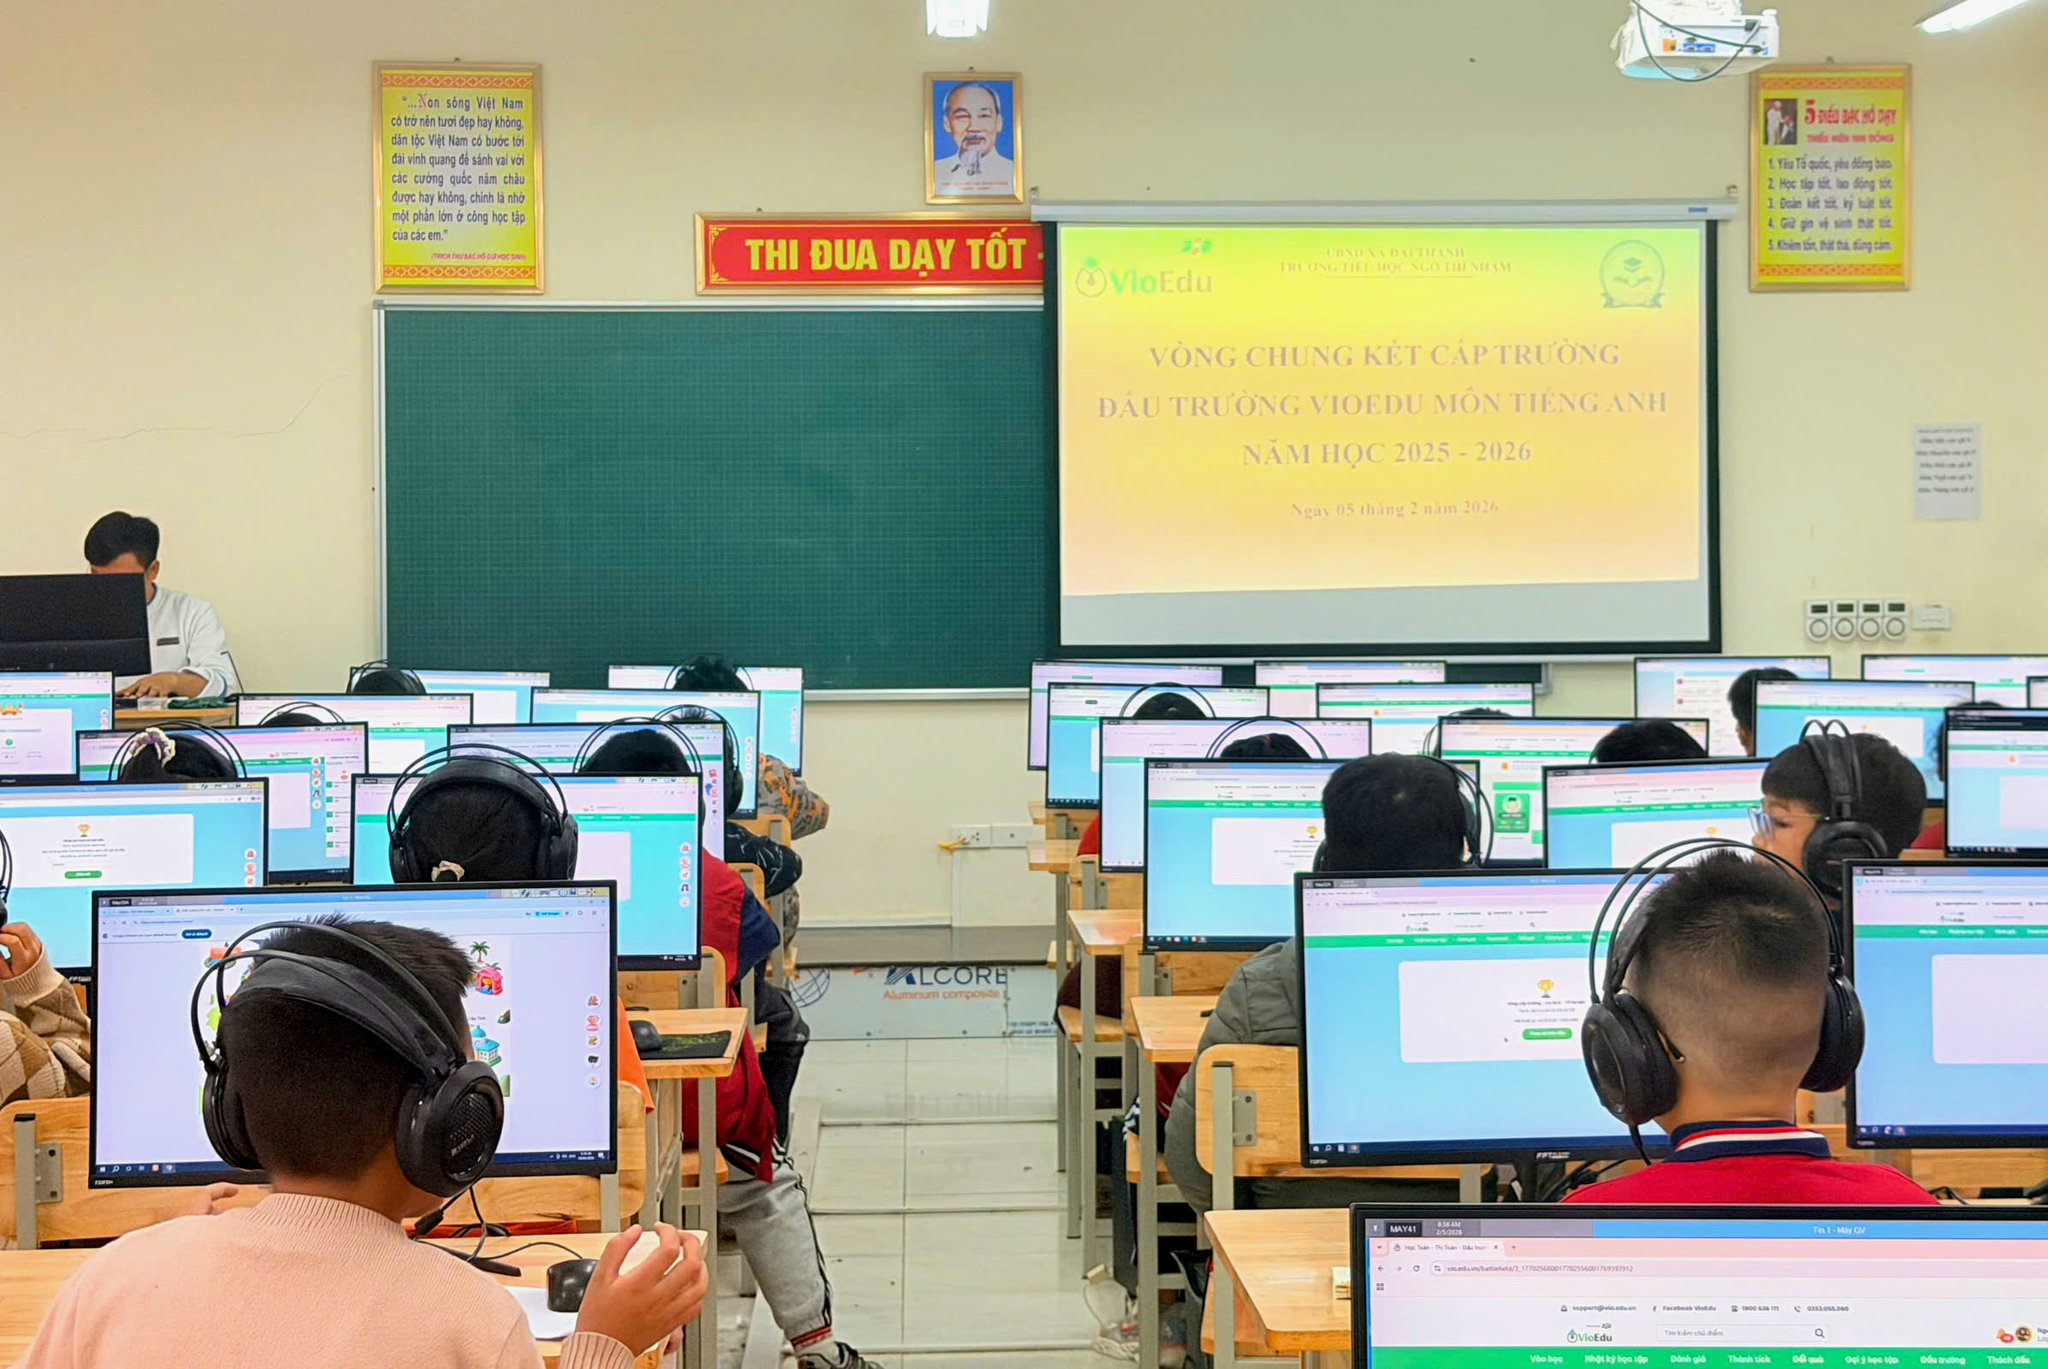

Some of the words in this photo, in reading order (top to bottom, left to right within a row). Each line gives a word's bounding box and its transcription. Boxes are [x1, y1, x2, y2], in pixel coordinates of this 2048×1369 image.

[447, 96, 470, 111] sông
[476, 96, 495, 110] Việt
[502, 97, 523, 109] Nam
[1805, 99, 1816, 124] 5
[391, 115, 401, 127] có
[404, 115, 417, 127] trở
[420, 115, 436, 127] nên
[438, 116, 457, 127] tươi
[458, 116, 475, 130] đẹp
[477, 116, 492, 130] hay
[391, 134, 407, 146] dân
[411, 134, 425, 148] tộc
[428, 134, 445, 149] Việt
[448, 136, 468, 146] Nam
[472, 135, 482, 147] có
[486, 134, 509, 147] bước
[512, 135, 524, 147] tới
[392, 173, 407, 184] các
[414, 173, 444, 187] cường
[450, 170, 472, 186] quốc
[478, 173, 497, 184] năm
[504, 173, 525, 184] châu
[392, 192, 416, 206] được
[419, 192, 434, 206] hay
[470, 191, 494, 204] chính
[497, 191, 504, 204] là
[508, 192, 525, 204] nhờ
[392, 211, 409, 225] một
[413, 210, 434, 224] phần
[438, 211, 453, 222] lớn
[456, 211, 463, 222] ở
[467, 211, 489, 225] công
[492, 211, 508, 225] học
[512, 211, 526, 225] tập
[392, 228, 408, 241] của
[411, 229, 426, 241] các
[745, 239, 799, 271] THI
[809, 239, 878, 271] ĐUA
[890, 239, 956, 278] DẠY
[965, 226, 1027, 271] TỐT
[1150, 340, 1236, 368] VÒNG
[1246, 345, 1353, 368] CHUNG
[1494, 338, 1619, 365] TRƯỜNG
[1169, 389, 1300, 417] TRƯỜNG
[1309, 393, 1423, 416] VIOEDU
[1433, 387, 1501, 415] MÔN
[1606, 391, 1667, 413] ANH
[1243, 439, 1310, 465] NĂM
[1321, 443, 1385, 470] HỌC
[1394, 442, 1450, 463] 2025
[1475, 441, 1532, 462] 2026
[1336, 503, 1355, 516] 05
[1410, 501, 1418, 515] 2
[1463, 500, 1499, 514] 2026
[943, 990, 999, 1000] composite
[1390, 1225, 1416, 1233] MAY41
[1578, 1333, 1612, 1342] VioEdu
